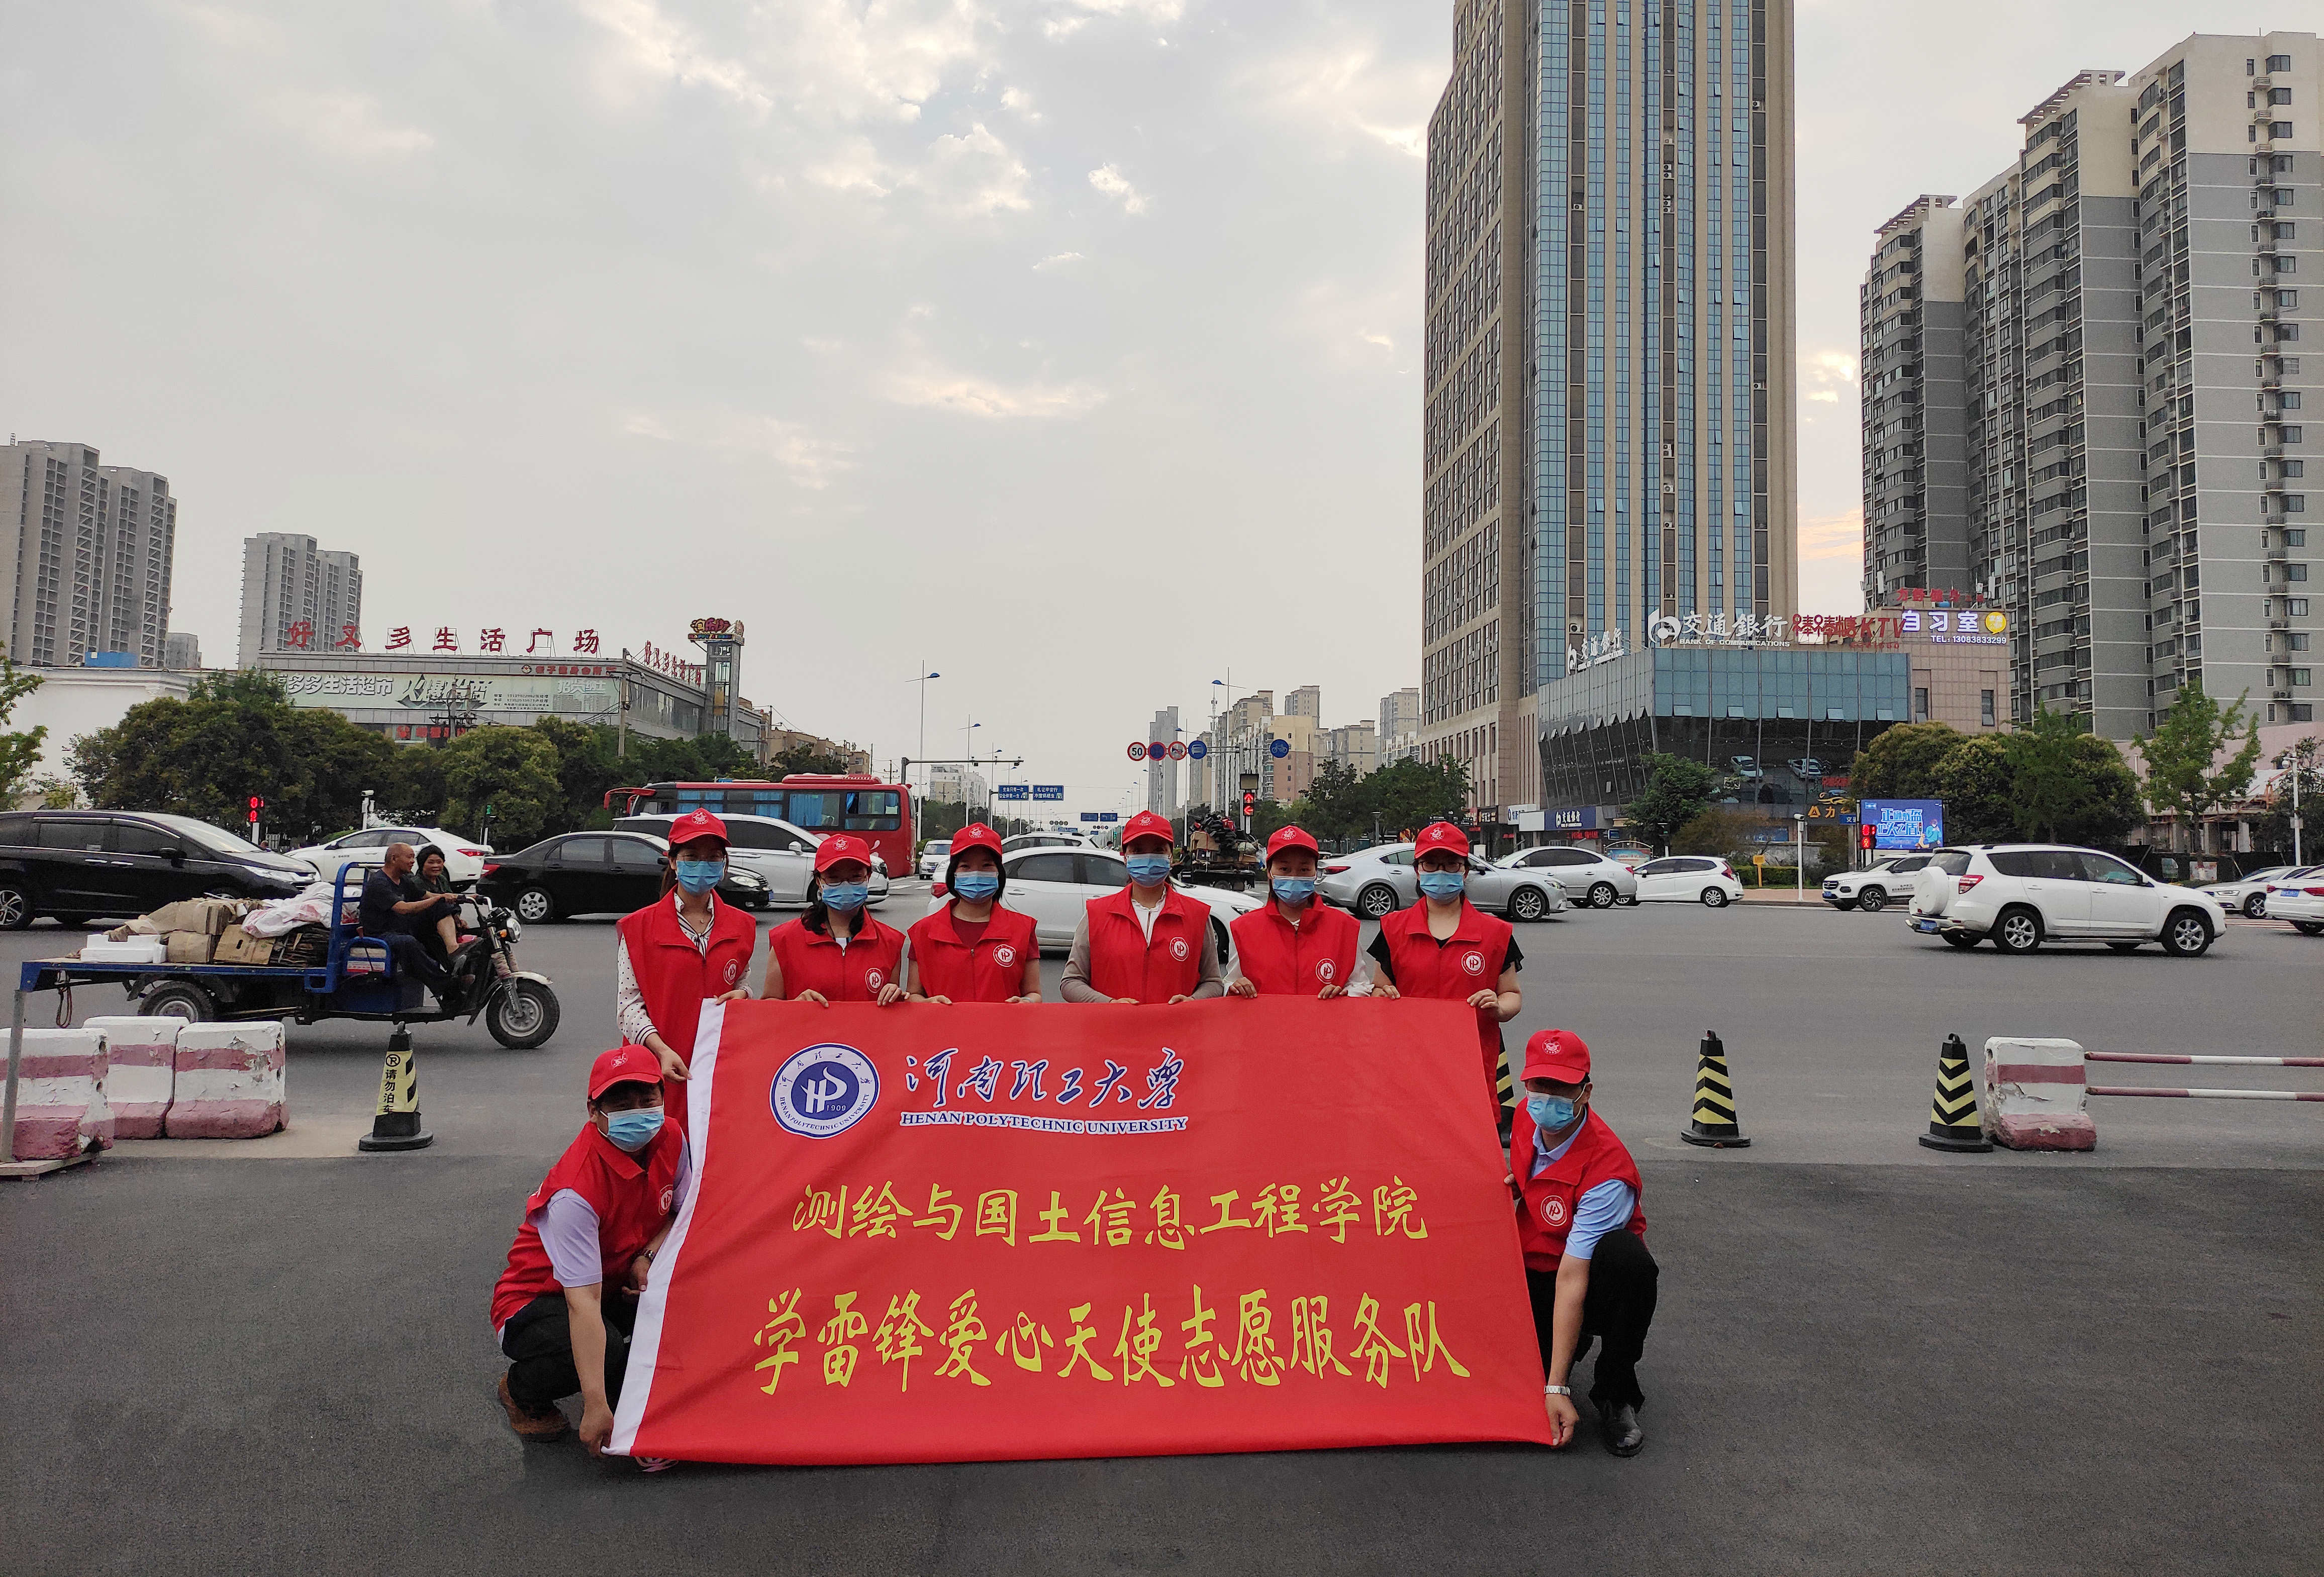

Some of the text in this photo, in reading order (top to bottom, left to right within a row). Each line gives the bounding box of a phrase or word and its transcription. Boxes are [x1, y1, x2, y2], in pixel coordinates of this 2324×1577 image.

[287, 620, 599, 653] 好又多生活广场
[1682, 610, 1788, 637] 交通銀行
[1902, 610, 1979, 632] 自习室
[1132, 747, 1142, 756] 50
[382, 1069, 397, 1114] 请勿泊车
[780, 1097, 792, 1119] HENAN
[839, 1093, 870, 1126] UNIVERSITY
[902, 1112, 1187, 1133] HENAN POLYTECHNIC UNIVERSITY
[793, 1176, 1428, 1250] 测绘与国土信息工程学院
[754, 1285, 1470, 1395] 学雷锋爱心天使志愿服务队
